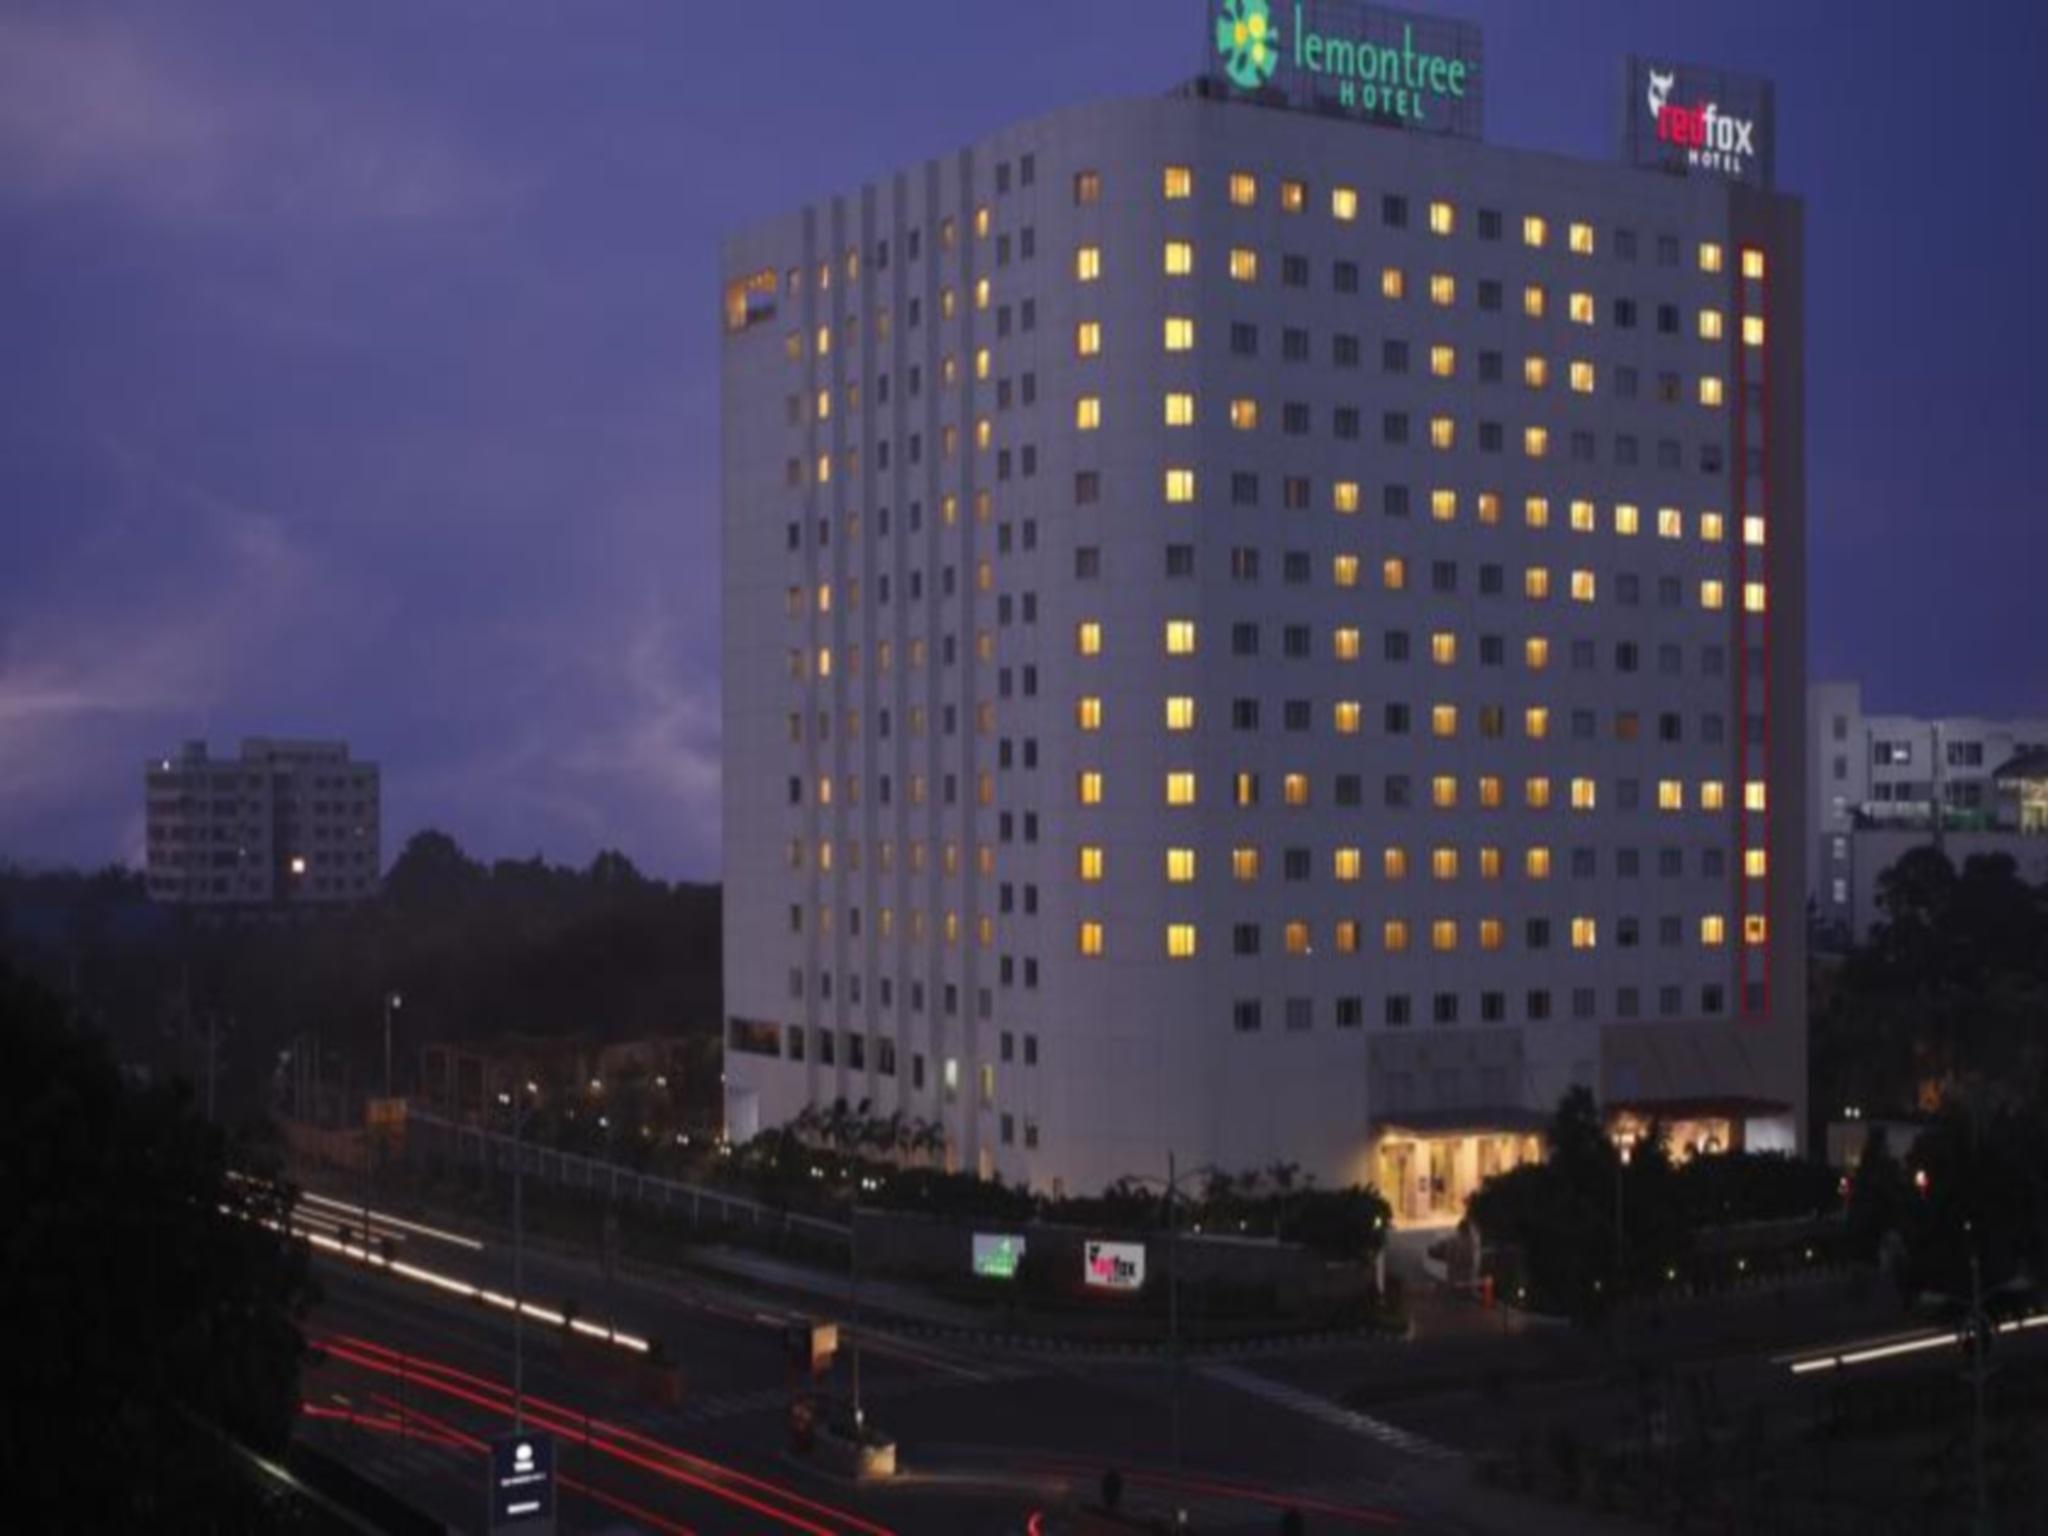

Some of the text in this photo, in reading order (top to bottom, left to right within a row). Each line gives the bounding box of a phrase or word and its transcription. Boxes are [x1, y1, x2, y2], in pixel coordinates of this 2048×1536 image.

[1295, 3, 1466, 95] lemontree
[1340, 80, 1424, 118] HOTEL
[1688, 149, 1741, 173] HOTEL
